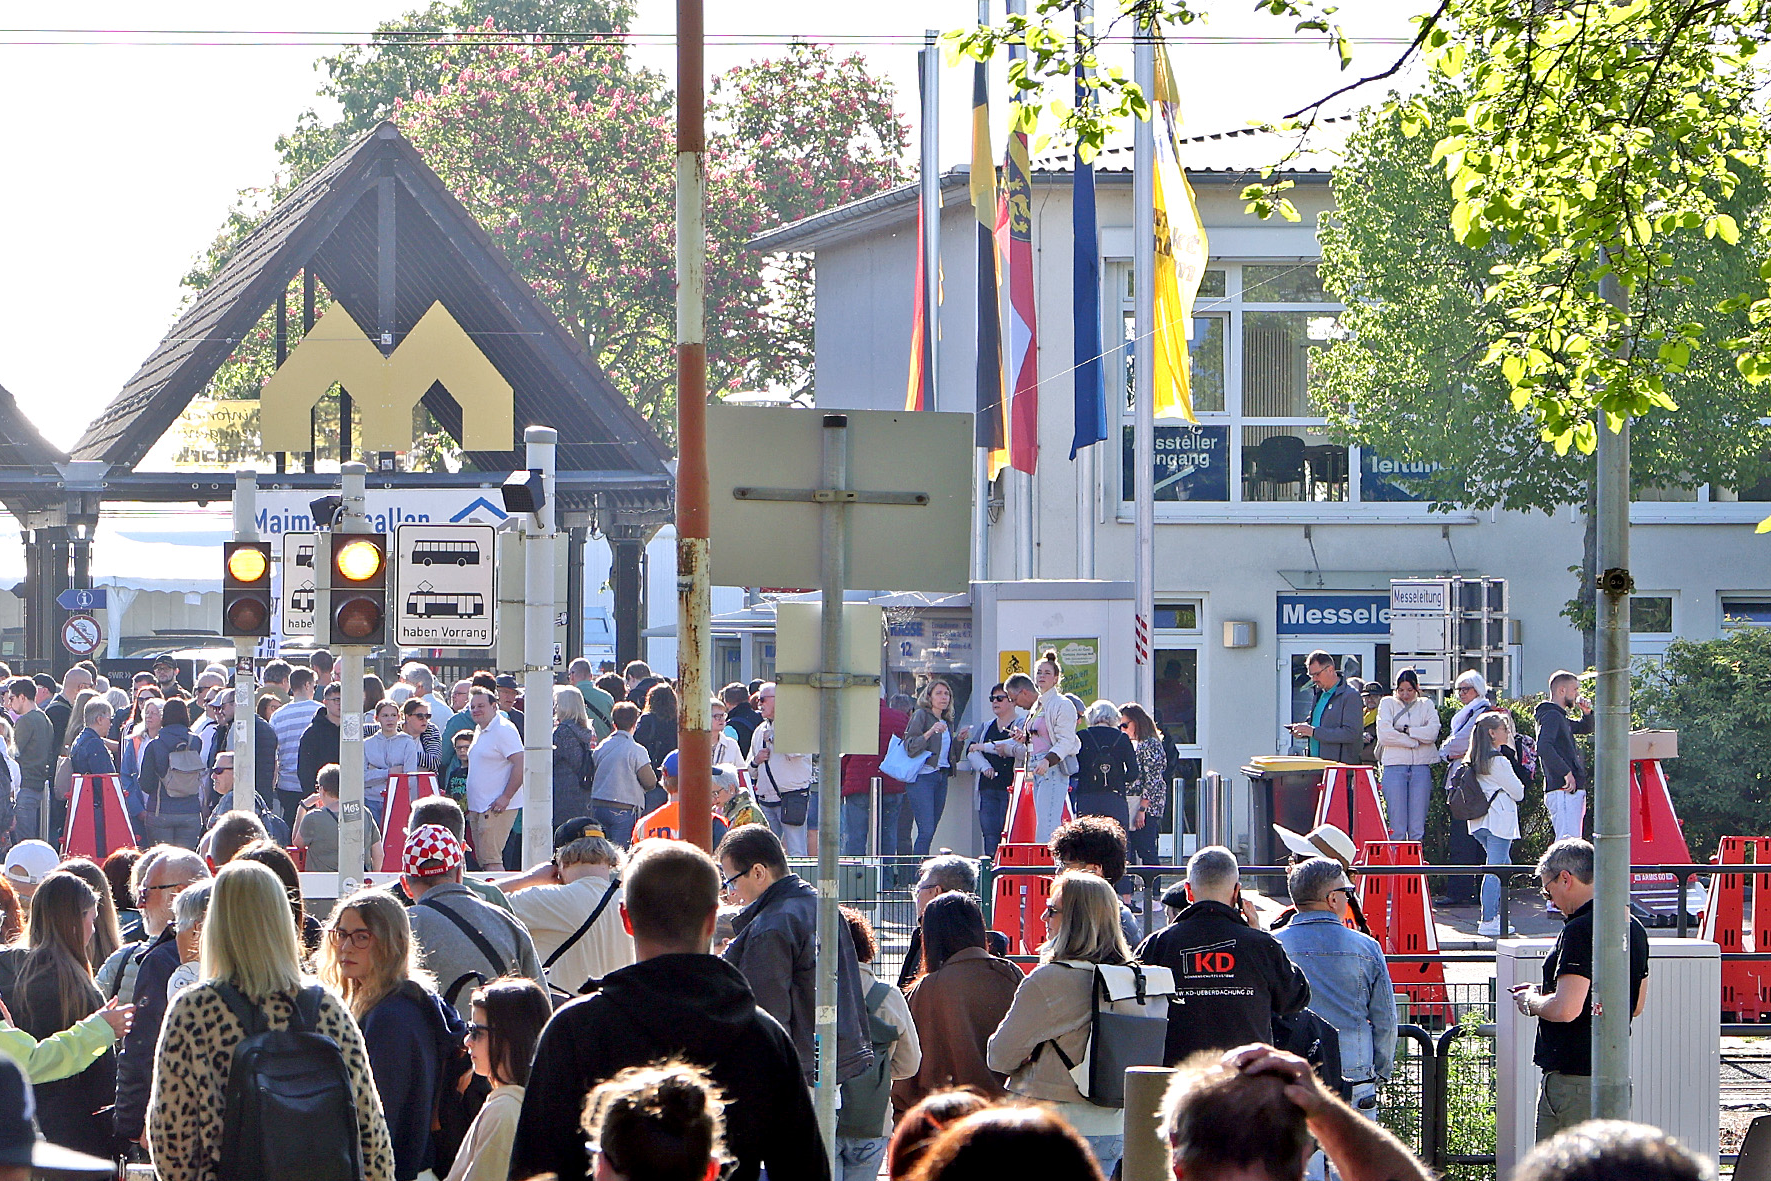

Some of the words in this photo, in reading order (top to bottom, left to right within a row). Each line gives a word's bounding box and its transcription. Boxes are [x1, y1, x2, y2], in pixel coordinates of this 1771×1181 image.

[1155, 434, 1218, 450] ssteller
[1154, 452, 1210, 469] ingang
[1371, 455, 1453, 473] leitun
[254, 507, 430, 534] Maimallen
[1394, 589, 1442, 607] Messeleitung
[1283, 603, 1391, 625] Messele
[288, 619, 313, 628] habe
[403, 626, 437, 637] haben
[441, 626, 487, 641] Vorrang
[900, 641, 913, 657] 12
[1194, 952, 1236, 973] KD
[1175, 989, 1254, 997] W.KD-UEBERDACHUNG.DE
